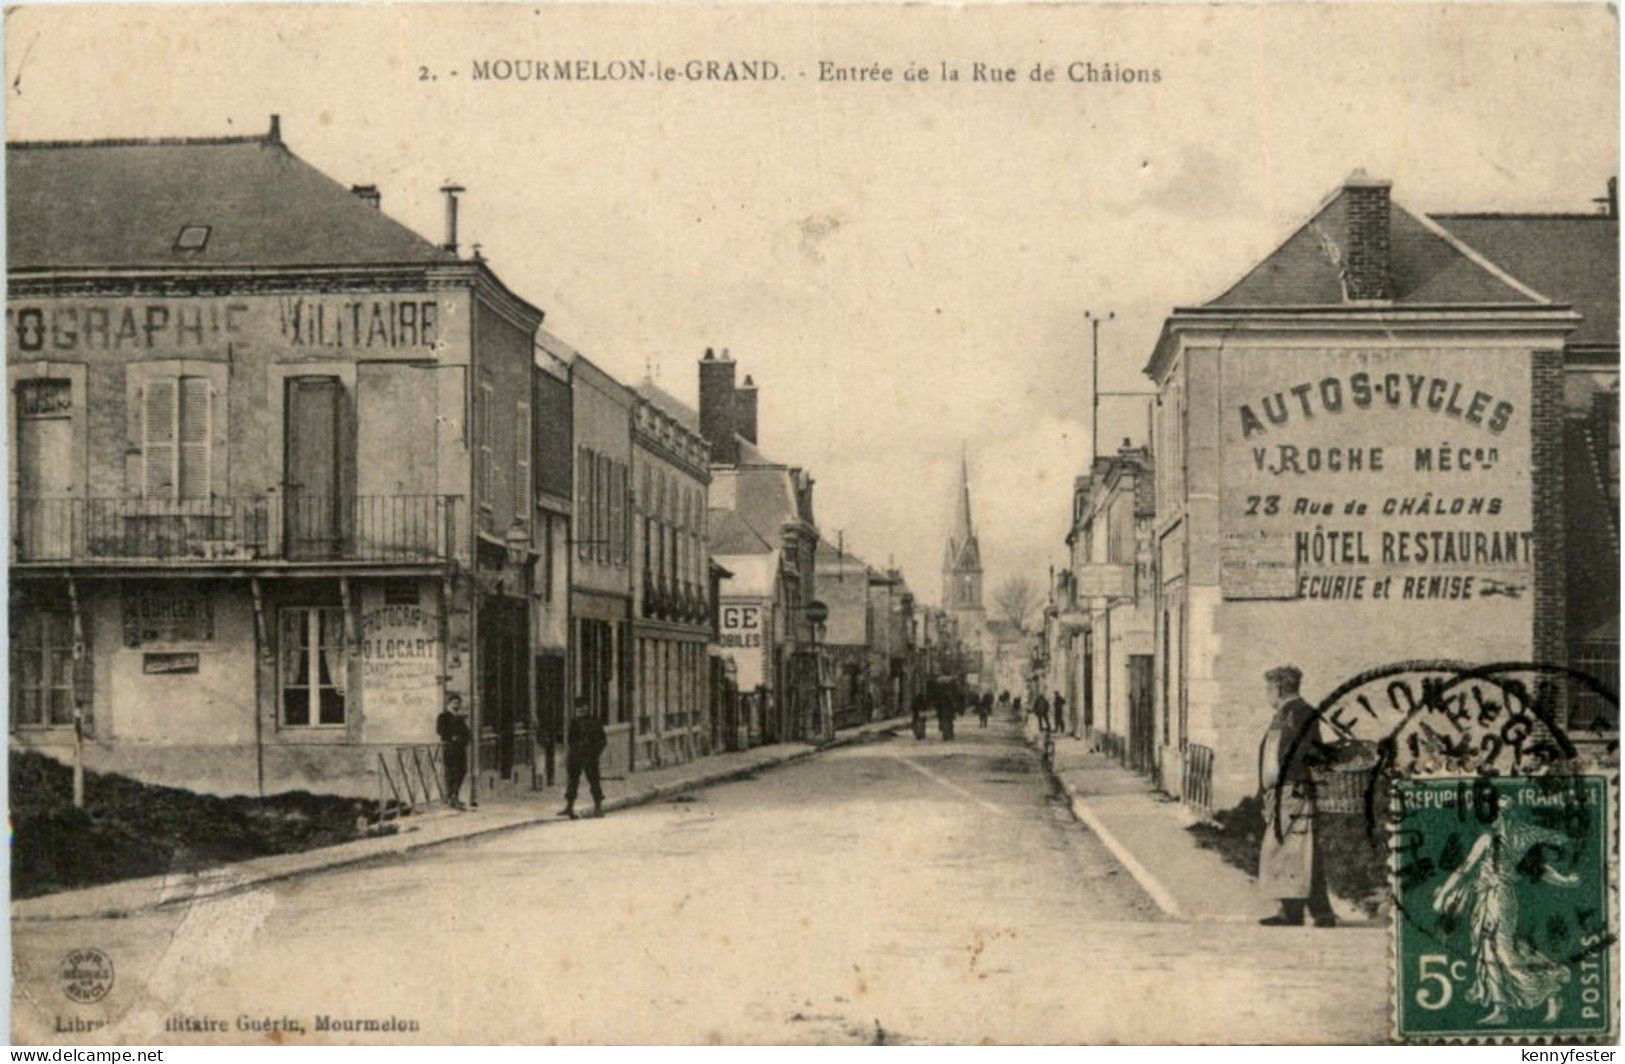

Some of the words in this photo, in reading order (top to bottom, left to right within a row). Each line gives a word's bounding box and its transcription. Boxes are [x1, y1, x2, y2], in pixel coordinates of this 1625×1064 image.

[7, 303, 248, 352] OGRAPHIE
[1244, 494, 1281, 515] 23
[1344, 498, 1367, 515] de
[1382, 492, 1502, 516] CHÂLONS
[1295, 524, 1370, 564] HÔTEL
[1382, 531, 1533, 564] RESTAURANT
[1372, 576, 1392, 599] et
[1402, 576, 1475, 599] REMISE
